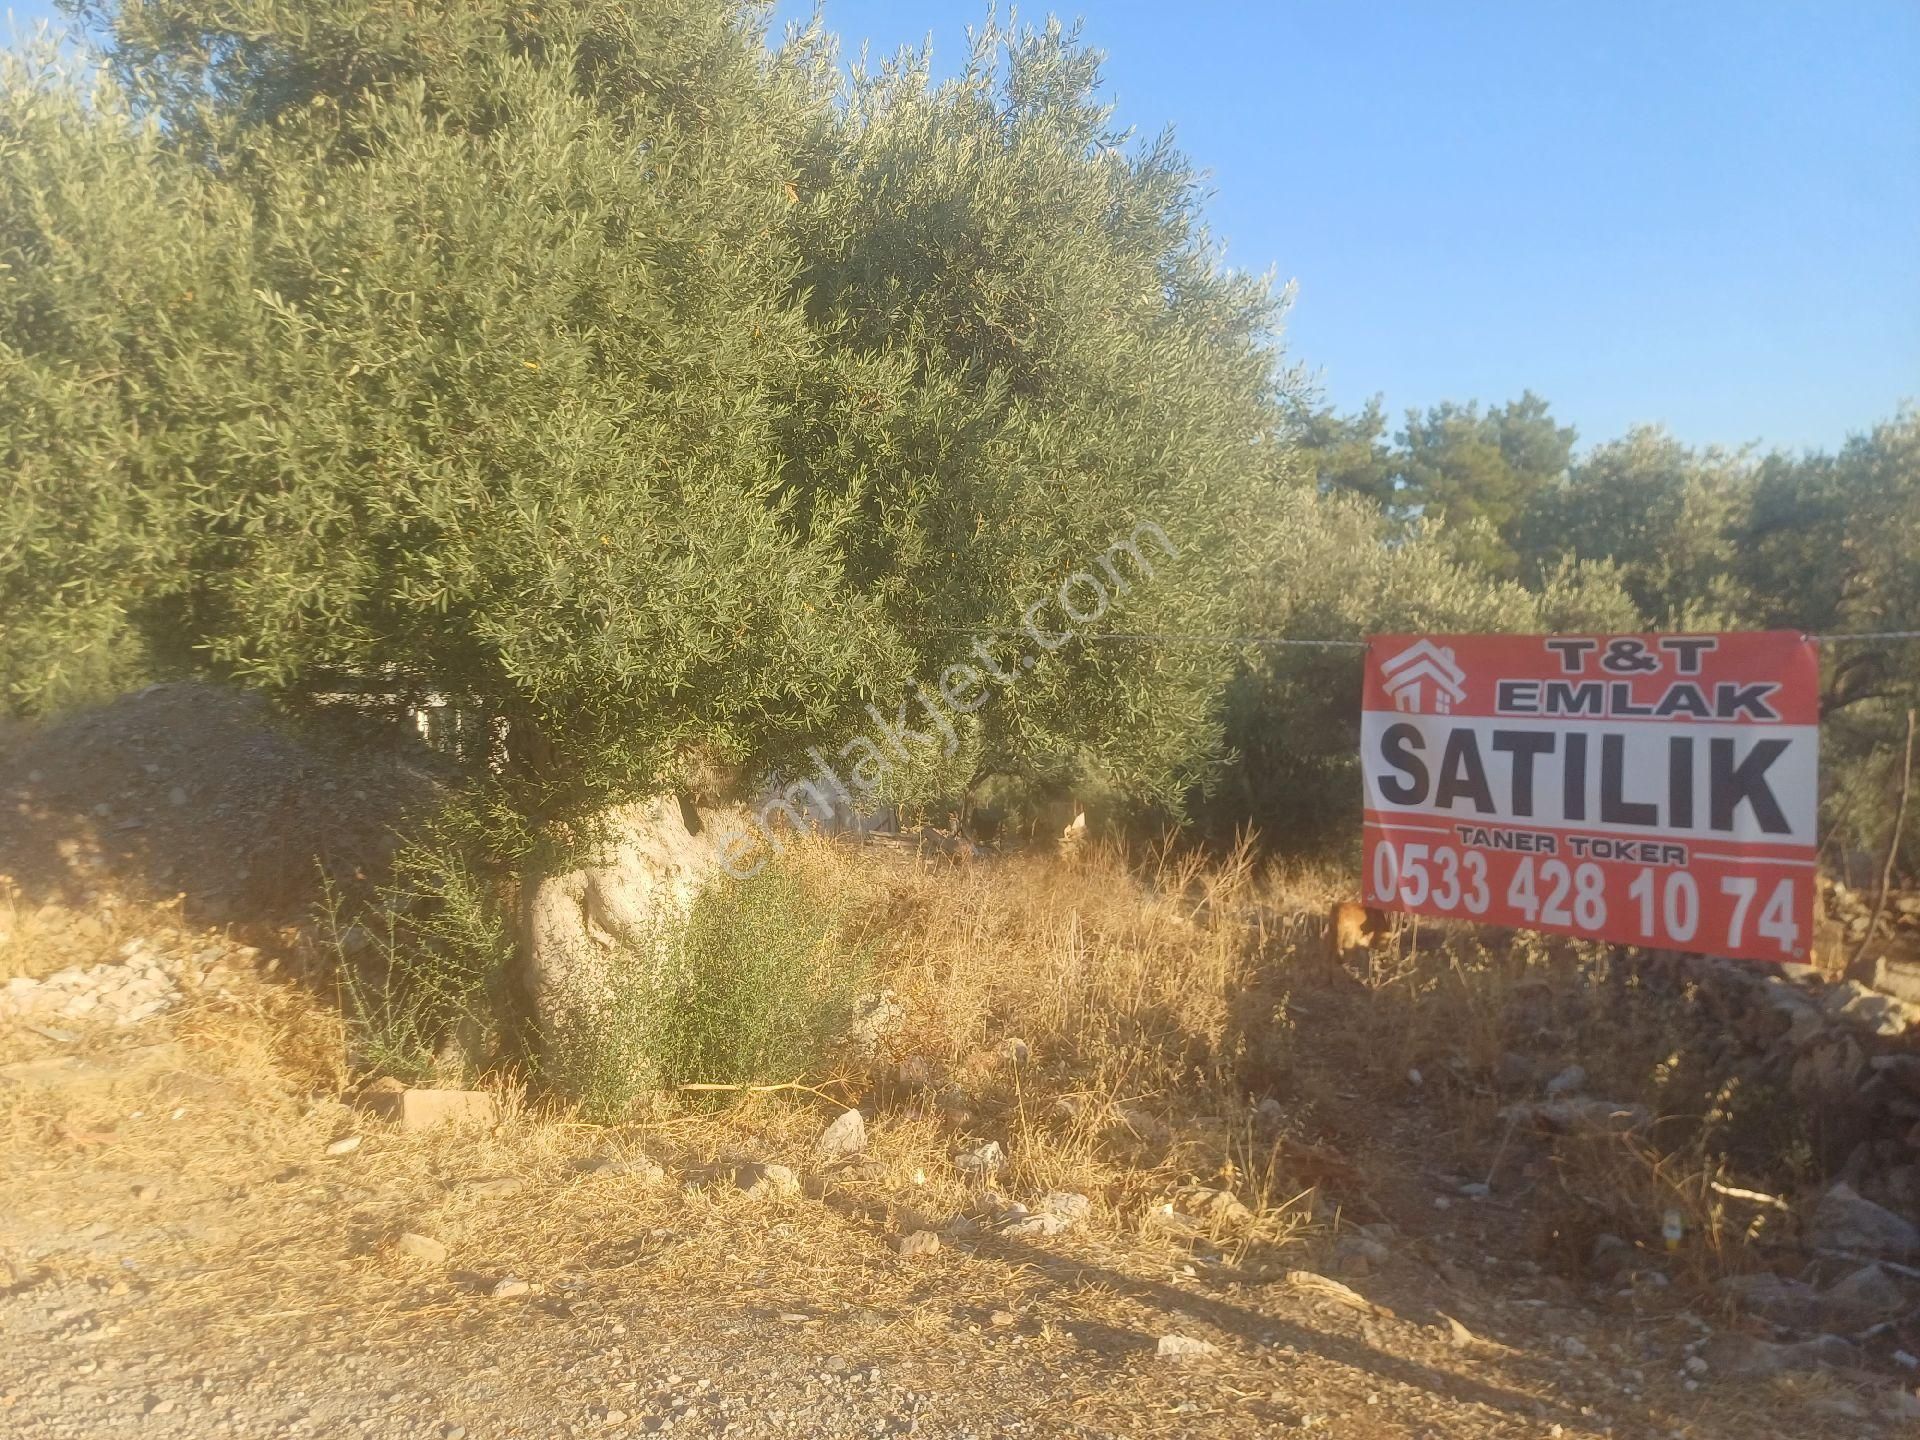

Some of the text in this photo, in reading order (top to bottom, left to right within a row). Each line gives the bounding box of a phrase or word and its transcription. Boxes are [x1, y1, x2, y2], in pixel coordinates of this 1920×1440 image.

[1547, 638, 1717, 674] T&T
[1496, 679, 1782, 721] EMLAK
[1377, 722, 1794, 835] SATILIK
[1457, 826, 1688, 866] TANER TOKER
[1373, 840, 1798, 952] 0533 428 10 74
